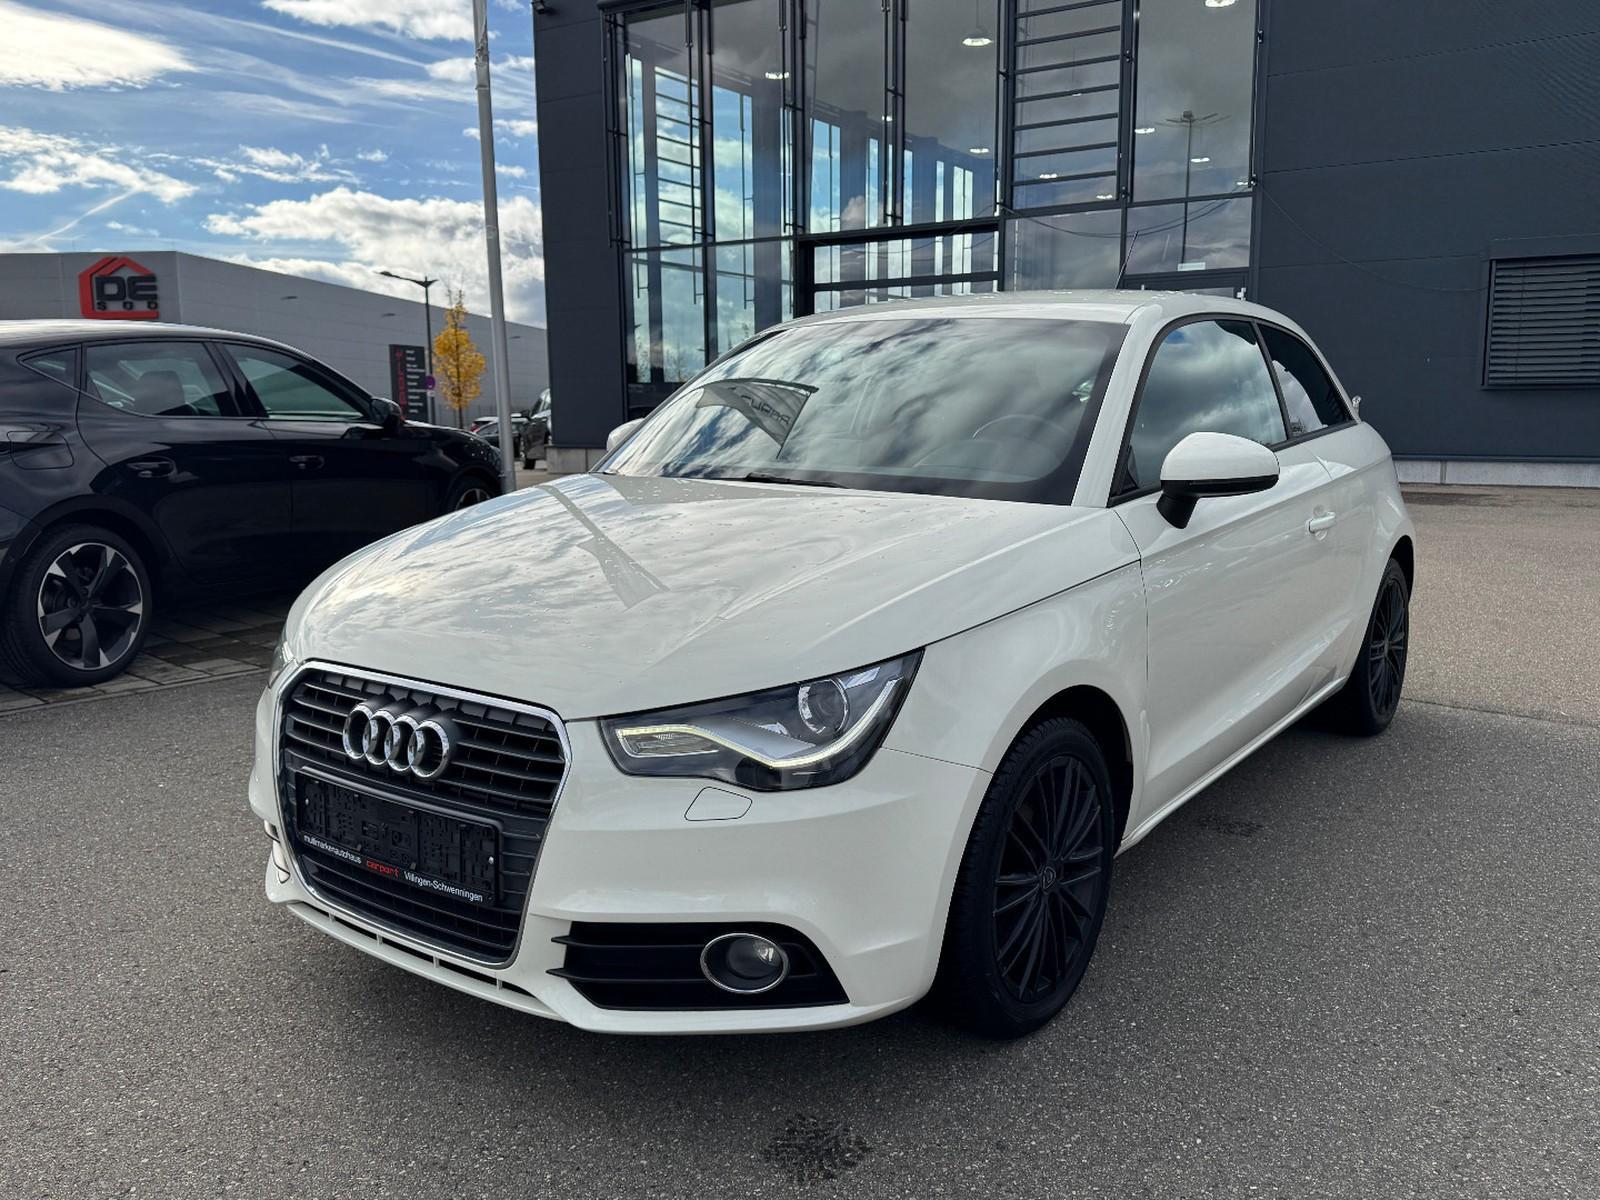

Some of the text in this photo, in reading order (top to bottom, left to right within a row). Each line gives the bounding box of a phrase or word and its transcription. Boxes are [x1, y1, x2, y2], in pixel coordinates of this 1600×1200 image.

[95, 275, 158, 300] DE
[366, 859, 399, 878] carpart
[403, 870, 483, 903] Villingen-Schwenningen
